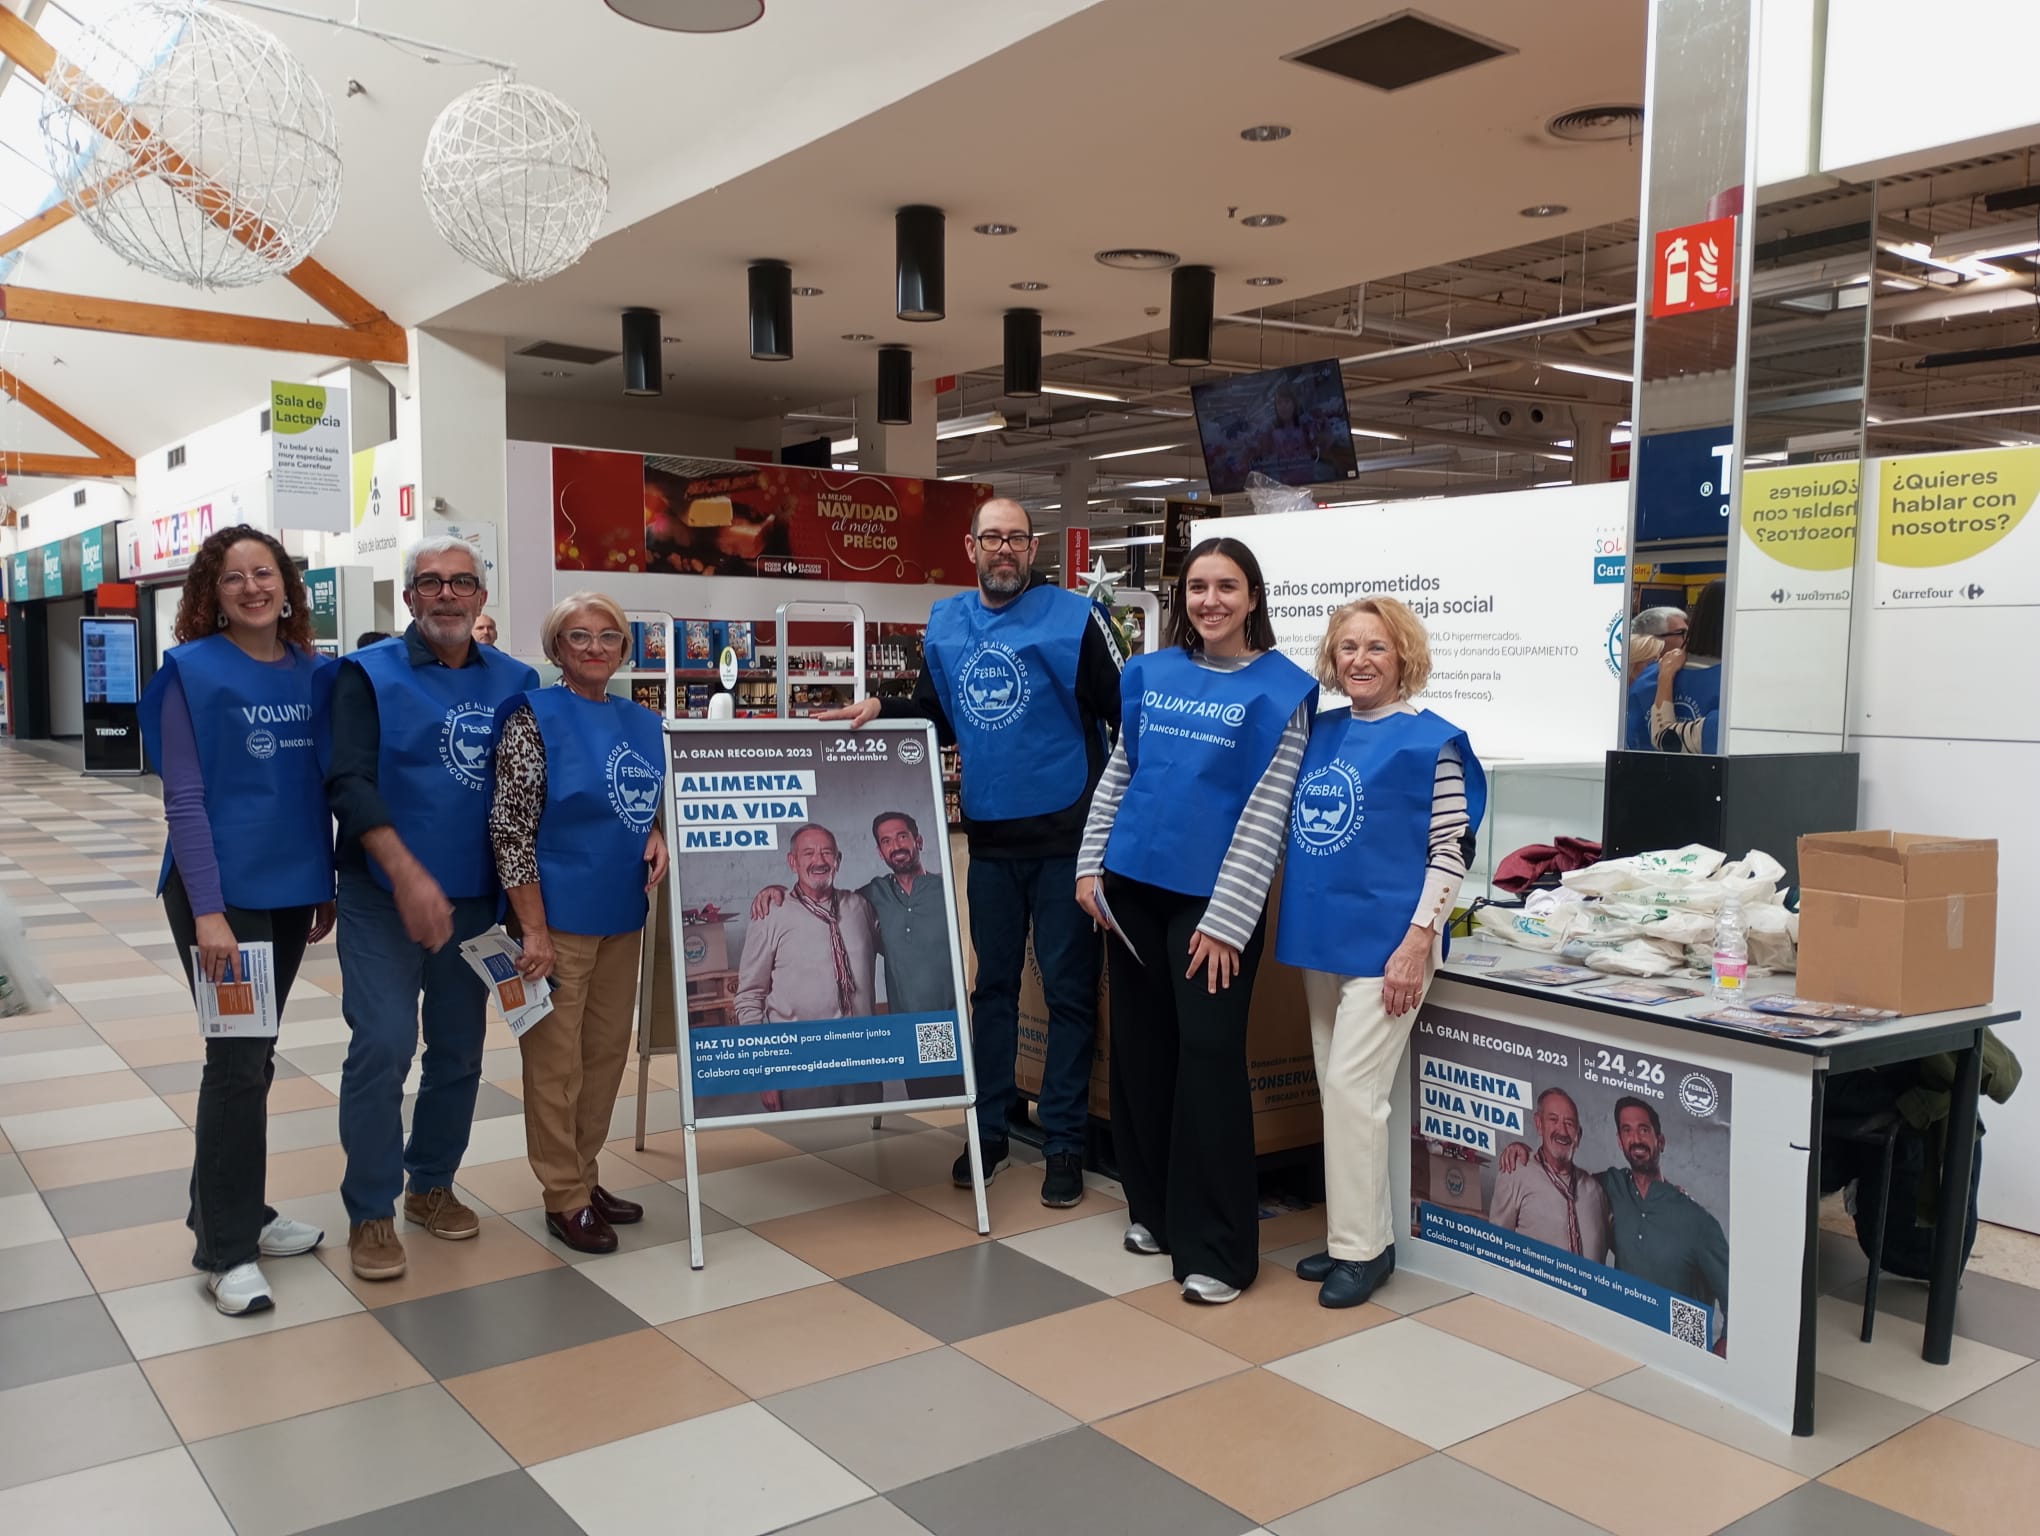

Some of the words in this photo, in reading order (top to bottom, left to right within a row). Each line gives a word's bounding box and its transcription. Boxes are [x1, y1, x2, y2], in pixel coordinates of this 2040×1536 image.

[275, 394, 304, 408] Sala
[306, 397, 324, 410] de
[276, 410, 341, 428] Lactancia
[1892, 470, 1998, 492] ¿Quieres
[827, 494, 852, 502] MEJOR
[1892, 493, 1968, 514] hablar
[1972, 492, 2017, 508] con
[817, 501, 898, 521] NAVIDAD
[831, 516, 847, 532] al
[849, 519, 886, 537] mejor
[1891, 514, 2011, 537] nosotros?
[843, 534, 898, 550] PRECIO
[1594, 537, 1622, 554] SOL
[1597, 563, 1625, 577] Carr
[1273, 580, 1308, 596] años
[1311, 574, 1440, 598] comprometidos
[1892, 587, 1954, 600] Carrefour
[1268, 603, 1324, 618] ersonas
[1408, 597, 1439, 619] taja
[1442, 595, 1494, 614] social
[1277, 634, 1292, 643] que
[1292, 632, 1303, 642] los
[1451, 631, 1522, 642] hipermercados.
[990, 640, 1028, 678] ALIMENTOS
[1429, 646, 1452, 656] ntros
[1453, 648, 1461, 658] y
[1461, 646, 1500, 656] donando
[1501, 646, 1579, 657] EQUIPAMIENTO
[973, 666, 1009, 679] FESBAL
[1426, 671, 1470, 681] portación
[1470, 672, 1492, 682] para
[1492, 671, 1501, 681] la
[1605, 658, 1621, 680] BANC
[1454, 689, 1495, 702] frescos).
[457, 702, 472, 712] DE
[474, 702, 495, 714] ALIM
[958, 692, 979, 727] BANCOS
[992, 688, 1031, 731] ALIMENTOS
[96, 728, 127, 736] TEMCO
[1149, 723, 1179, 737] BANCOS
[1179, 729, 1190, 738] DE
[1190, 731, 1236, 749] ALIMENTOS
[673, 750, 688, 760] LA
[690, 748, 725, 759] GRAN
[727, 748, 784, 759] RECOGIDA
[786, 748, 813, 758] 2023
[835, 739, 857, 753] 24
[865, 738, 887, 753] 26
[605, 745, 622, 781] BANCOS
[826, 753, 838, 762] de
[840, 753, 888, 762] noviembre
[439, 746, 469, 785] BANCOS
[470, 781, 483, 791] DE
[681, 774, 803, 792] ALIMENTA
[1333, 757, 1365, 802] ALIMENTOS
[1305, 784, 1345, 798] FESBAL
[608, 792, 631, 829] BANCOS
[631, 824, 640, 834] DE
[683, 803, 738, 820] UNA
[743, 802, 804, 819] VIDA
[685, 830, 770, 848] MEJOR
[1305, 844, 1318, 856] DE
[1318, 814, 1365, 857] ALIMENTOS
[695, 1040, 718, 1050] HAZ
[721, 1039, 735, 1049] TU
[738, 1033, 798, 1047] DONACIÓN
[800, 1034, 821, 1045] para
[824, 1030, 864, 1041] alimentar
[865, 1028, 891, 1040] juntos
[1419, 1021, 1434, 1034] LA
[1436, 1024, 1469, 1042] GRAN
[1472, 1032, 1533, 1059] RECOGIDA
[1536, 1049, 1569, 1067] 2023
[696, 1054, 713, 1062] una
[715, 1051, 735, 1060] vida
[737, 1050, 750, 1059] sin
[752, 1048, 792, 1060] pobreza.
[697, 1067, 740, 1079] Colabora
[742, 1065, 763, 1077] aquí
[764, 1055, 905, 1074] granrecogidadealimentos.org
[1584, 1058, 1596, 1068] Del
[1597, 1050, 1626, 1074] 24
[1627, 1069, 1635, 1077] al
[1636, 1059, 1666, 1084] 26
[1424, 1060, 1521, 1101] ALIMENTA
[1584, 1069, 1599, 1082] de
[1602, 1074, 1665, 1100] noviembre
[1425, 1087, 1466, 1115] UNA
[1472, 1099, 1521, 1131] VIDA
[1425, 1116, 1490, 1149] MEJOR
[1426, 1212, 1444, 1226] HAZ
[1445, 1218, 1456, 1230] TU
[1457, 1222, 1503, 1246] DONACIÓN
[1504, 1241, 1521, 1253] para
[1522, 1245, 1555, 1265] alimentar
[1556, 1258, 1577, 1274] juntos
[1578, 1269, 1592, 1281] una
[1593, 1274, 1610, 1288] vida
[1612, 1281, 1623, 1292] sin
[1624, 1285, 1659, 1307] pobreza.
[1426, 1228, 1458, 1247] Colabora
[1459, 1238, 1476, 1252] aquí
[1476, 1245, 1588, 1297] granrecogidadealimentos.org
